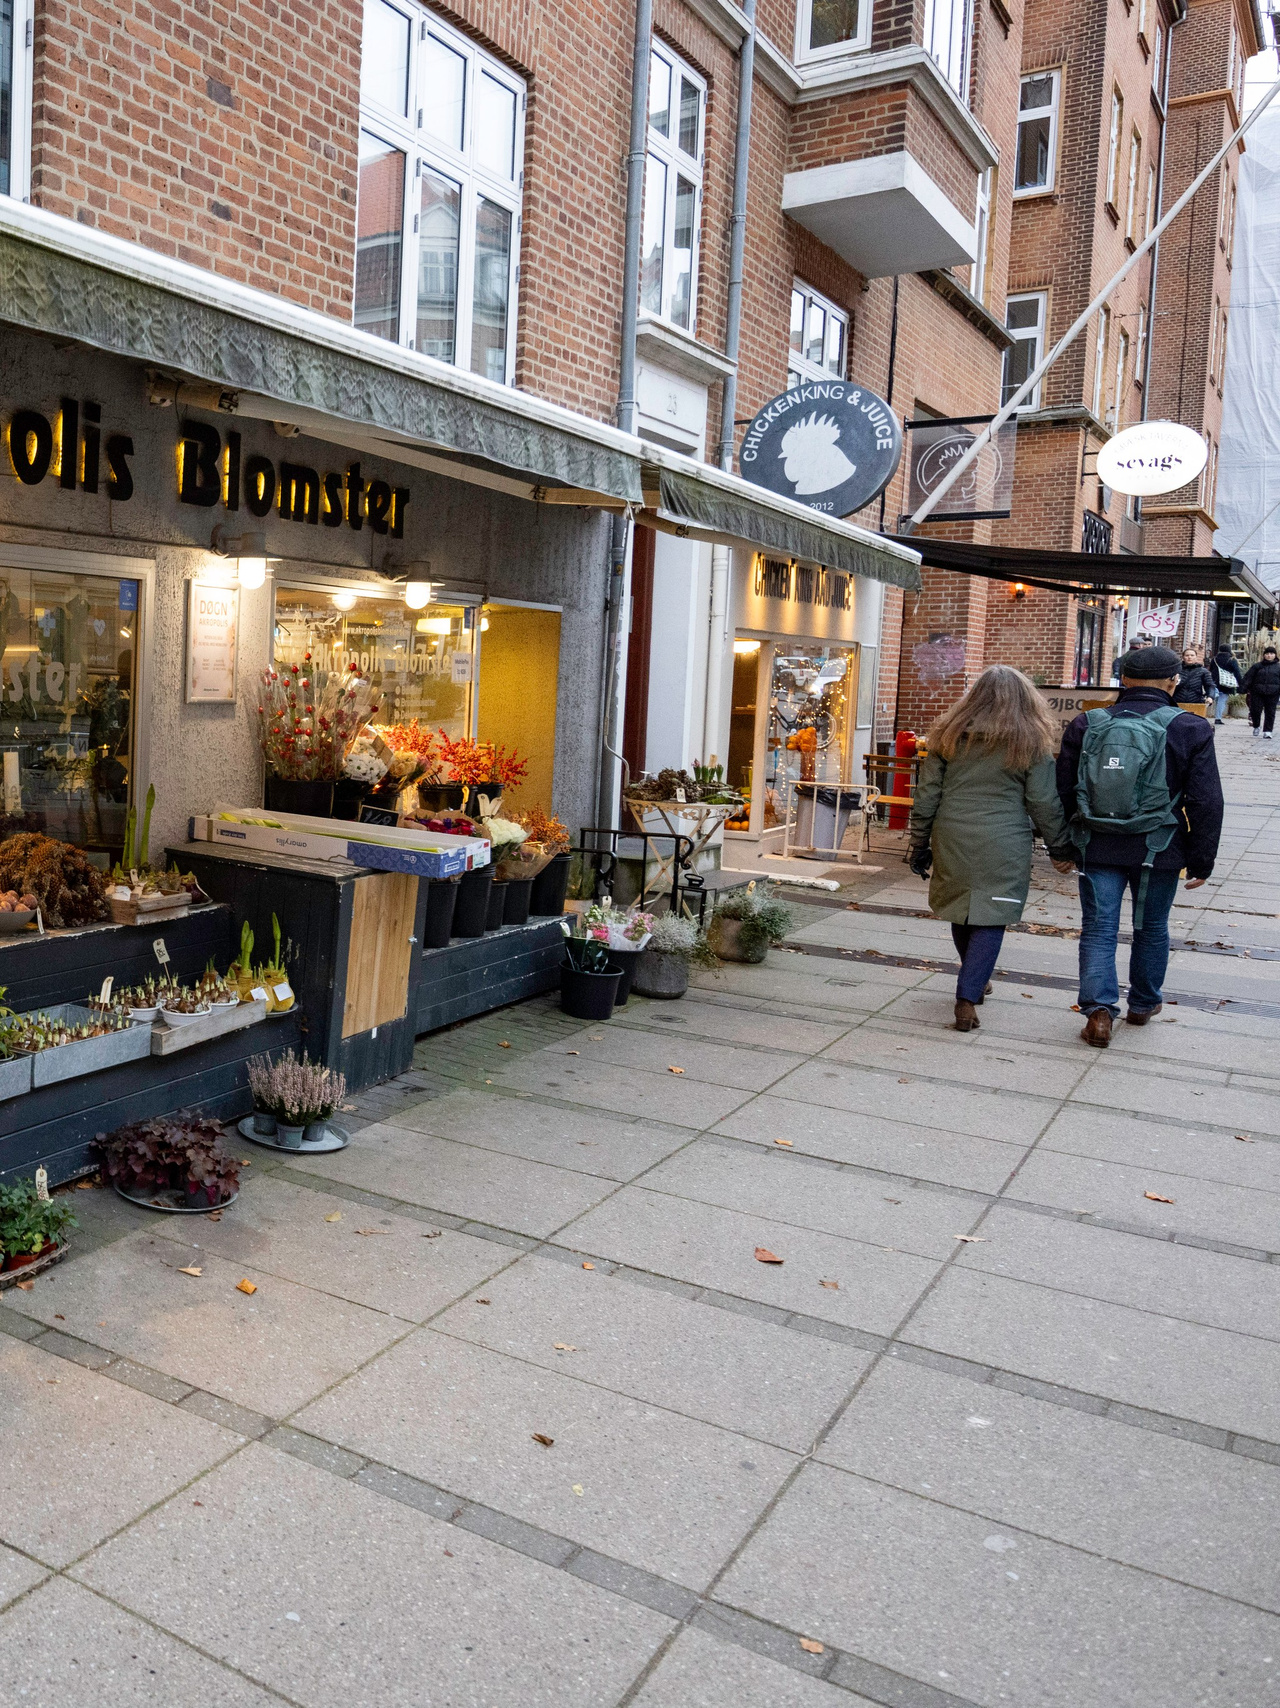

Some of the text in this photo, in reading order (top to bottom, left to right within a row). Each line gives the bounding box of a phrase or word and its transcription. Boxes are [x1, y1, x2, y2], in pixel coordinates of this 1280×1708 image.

[860, 401, 893, 451] JUICE
[179, 419, 411, 538] Blomster
[809, 501, 834, 511] 2012
[199, 600, 228, 617] DØGN
[275, 837, 308, 848] amaryllis
